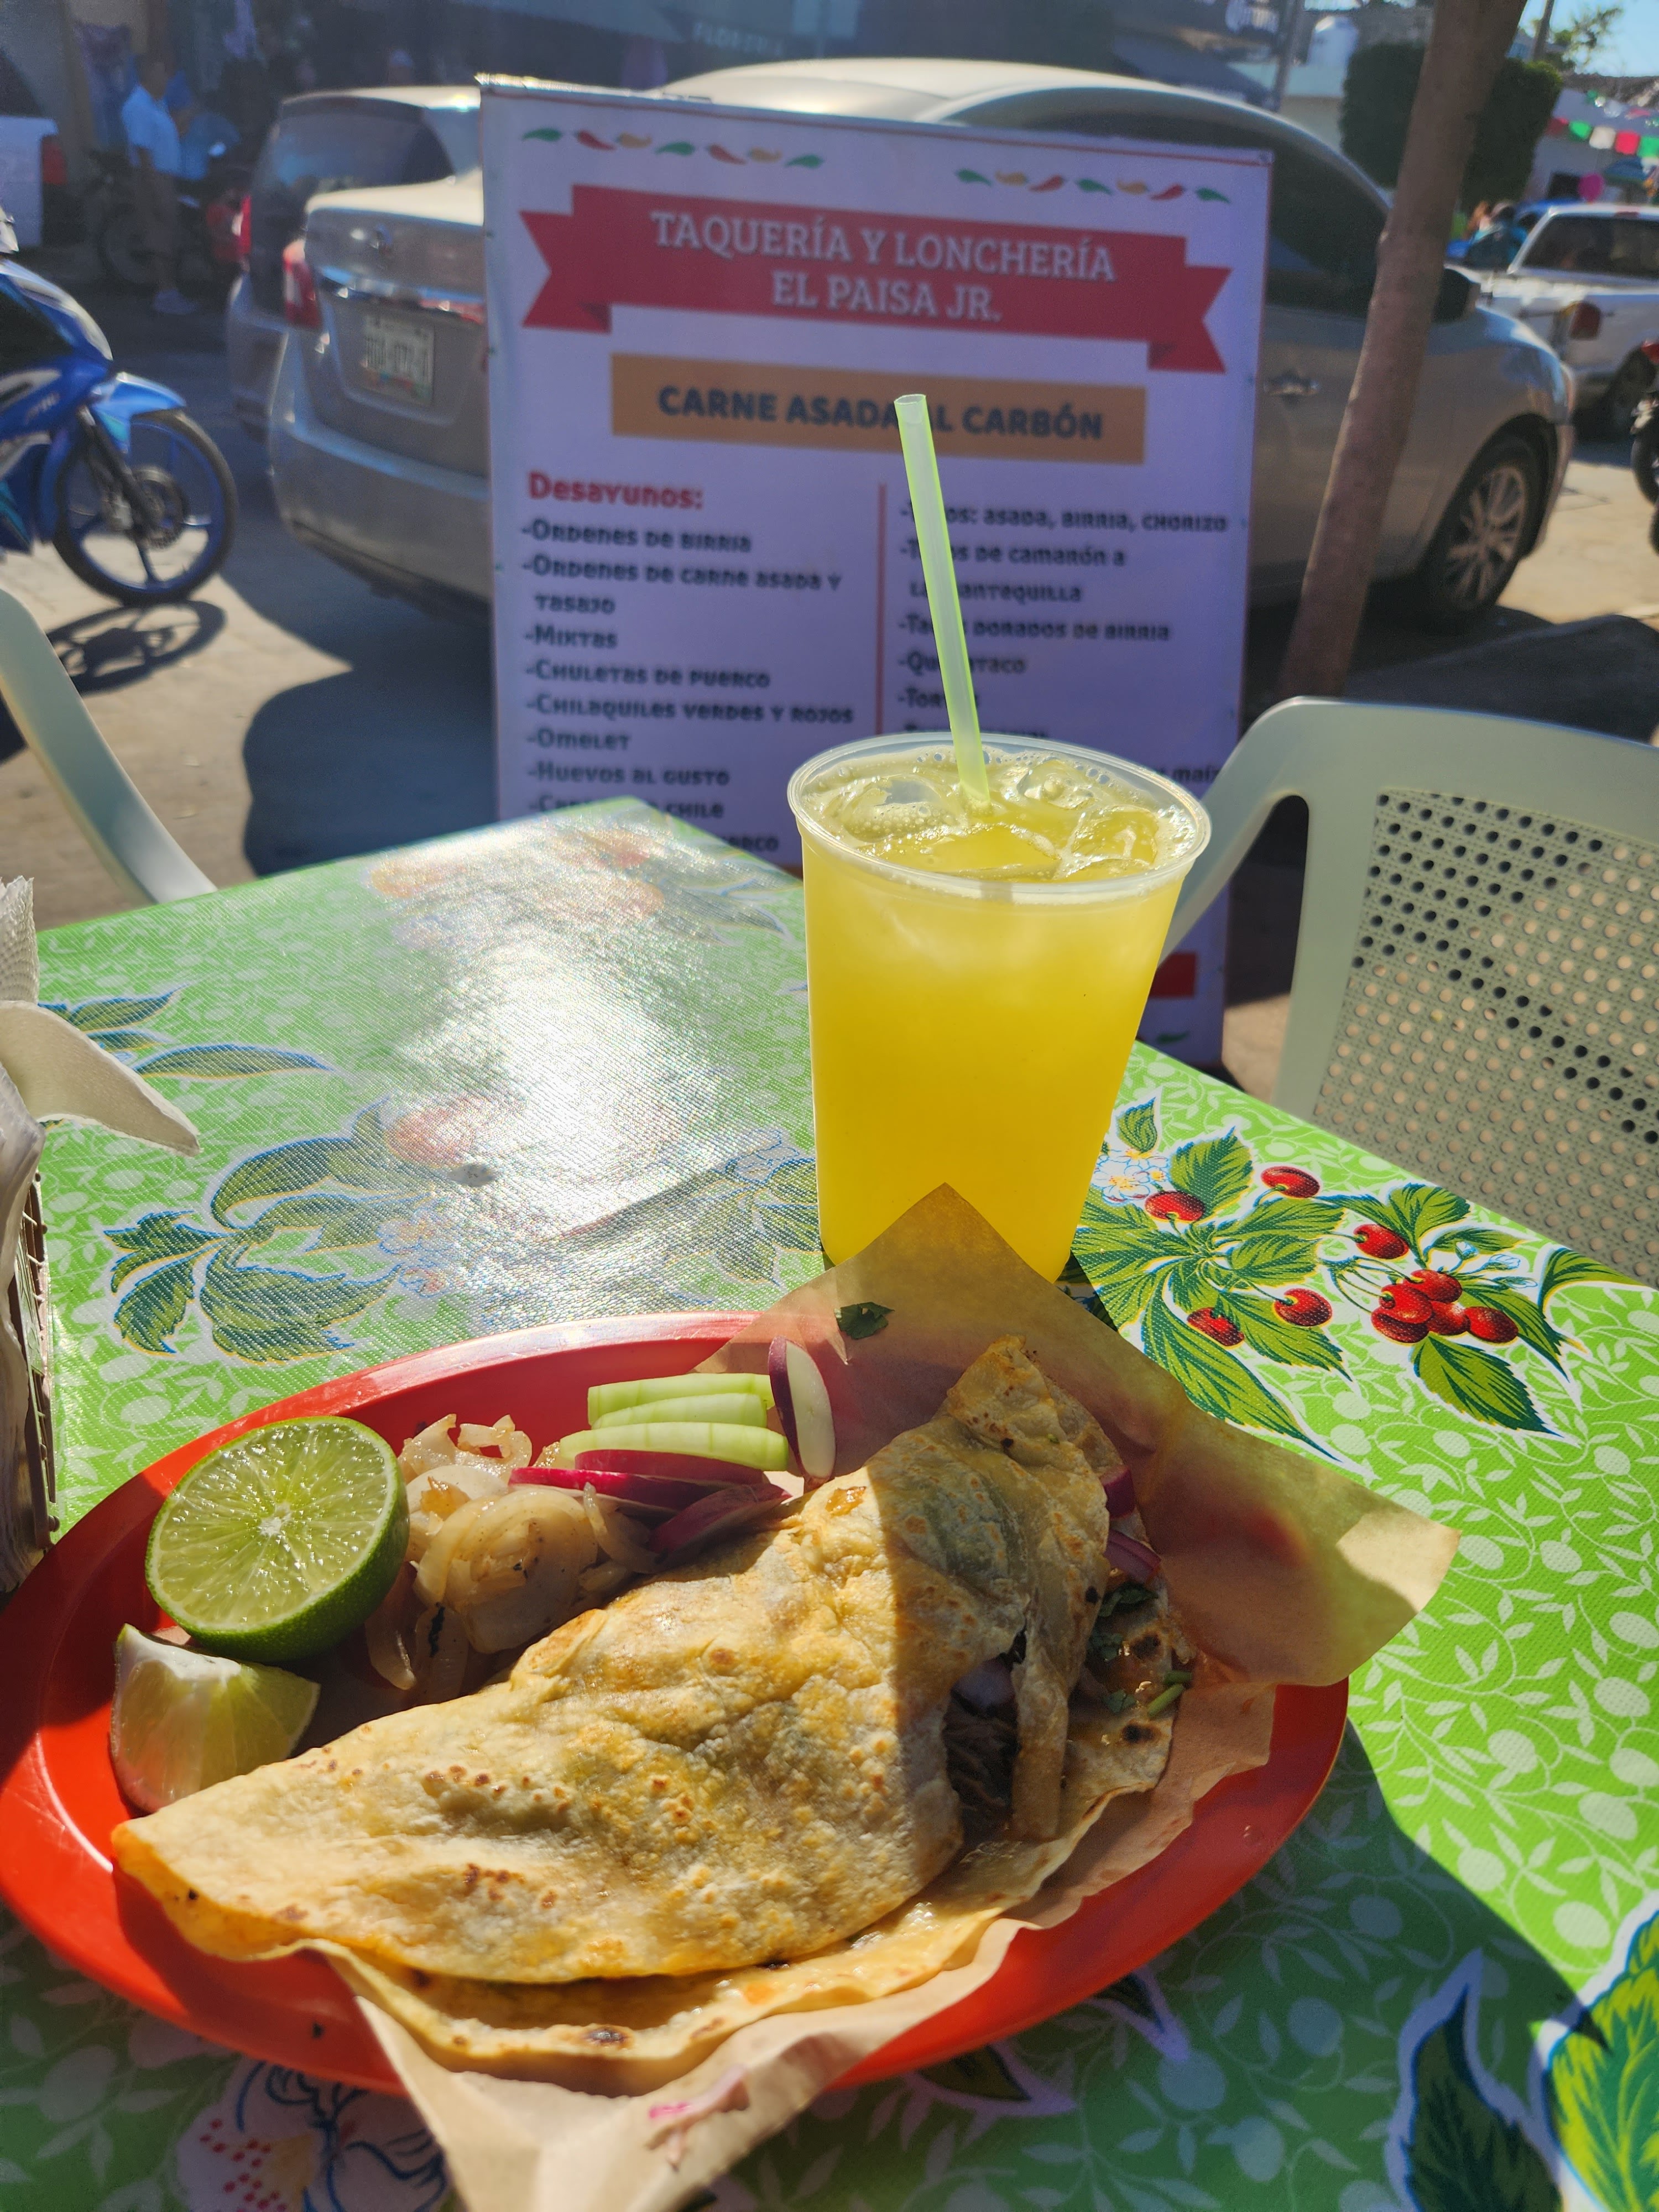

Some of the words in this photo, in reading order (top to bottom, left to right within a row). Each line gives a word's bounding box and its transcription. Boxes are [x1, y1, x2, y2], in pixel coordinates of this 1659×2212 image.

[650, 210, 851, 263] TAQUERÍA
[861, 229, 886, 265] Y
[896, 231, 1116, 283] LONCHERÍA
[773, 271, 817, 309] EL
[828, 274, 936, 318] PAISA
[947, 285, 1000, 322] JR.
[658, 387, 776, 423] CARNE
[786, 399, 899, 435] ASADA
[962, 403, 1102, 440] CARBÓN
[956, 582, 1082, 606] antequilla
